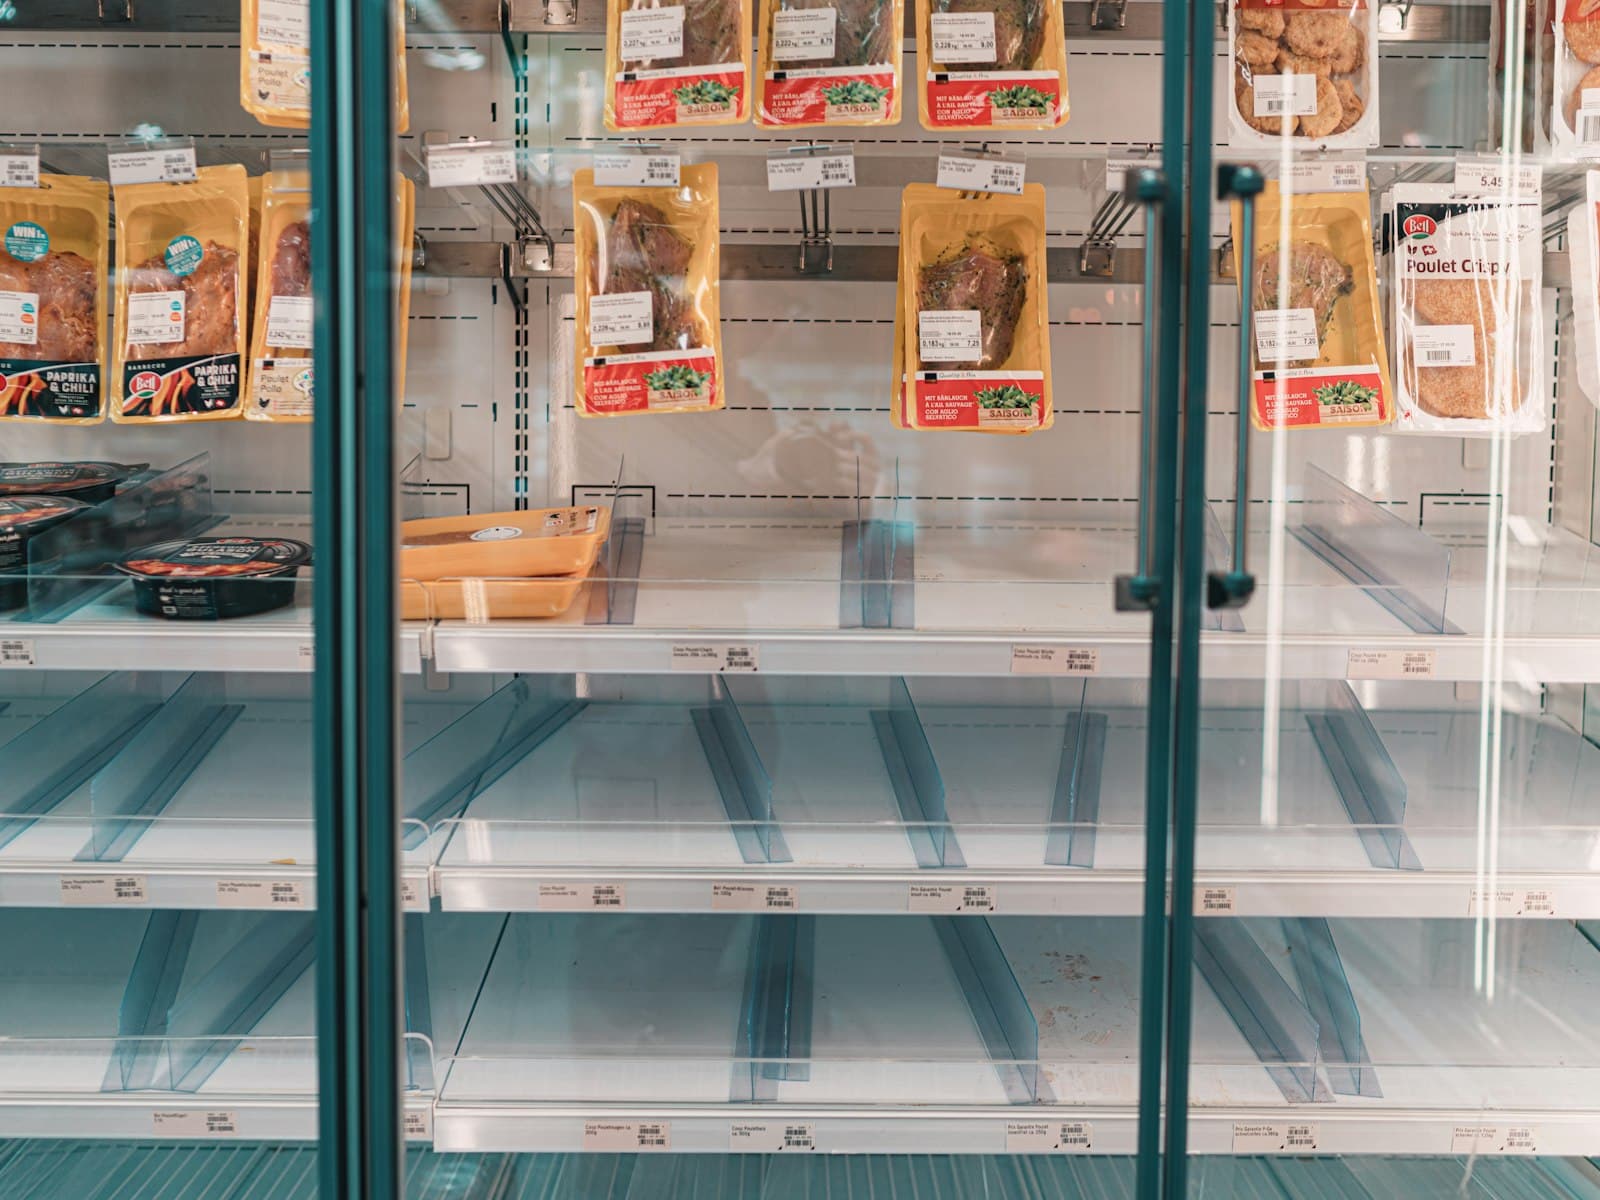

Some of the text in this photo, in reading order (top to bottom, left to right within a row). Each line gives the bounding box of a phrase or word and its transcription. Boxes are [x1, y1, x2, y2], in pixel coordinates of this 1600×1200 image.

[686, 103, 726, 114] SAISON
[836, 104, 876, 114] SAISON
[1002, 107, 1042, 117] SAISON
[1409, 219, 1430, 233] Bell
[13, 226, 36, 238] WIN
[168, 239, 189, 256] WIN
[1407, 259, 1457, 273] Poulet
[127, 363, 166, 371] BARBECUE
[194, 364, 238, 377] PAPRIKA
[46, 371, 97, 383] PAPRIKA
[197, 374, 235, 387] & CHILI
[261, 374, 289, 384] Poulet
[49, 382, 94, 393] & CHILI
[135, 375, 156, 391] Bell
[261, 384, 282, 392] Pollo
[660, 390, 698, 400] SAISON
[989, 409, 1028, 418] SAISON
[1330, 405, 1368, 415] SAISON
